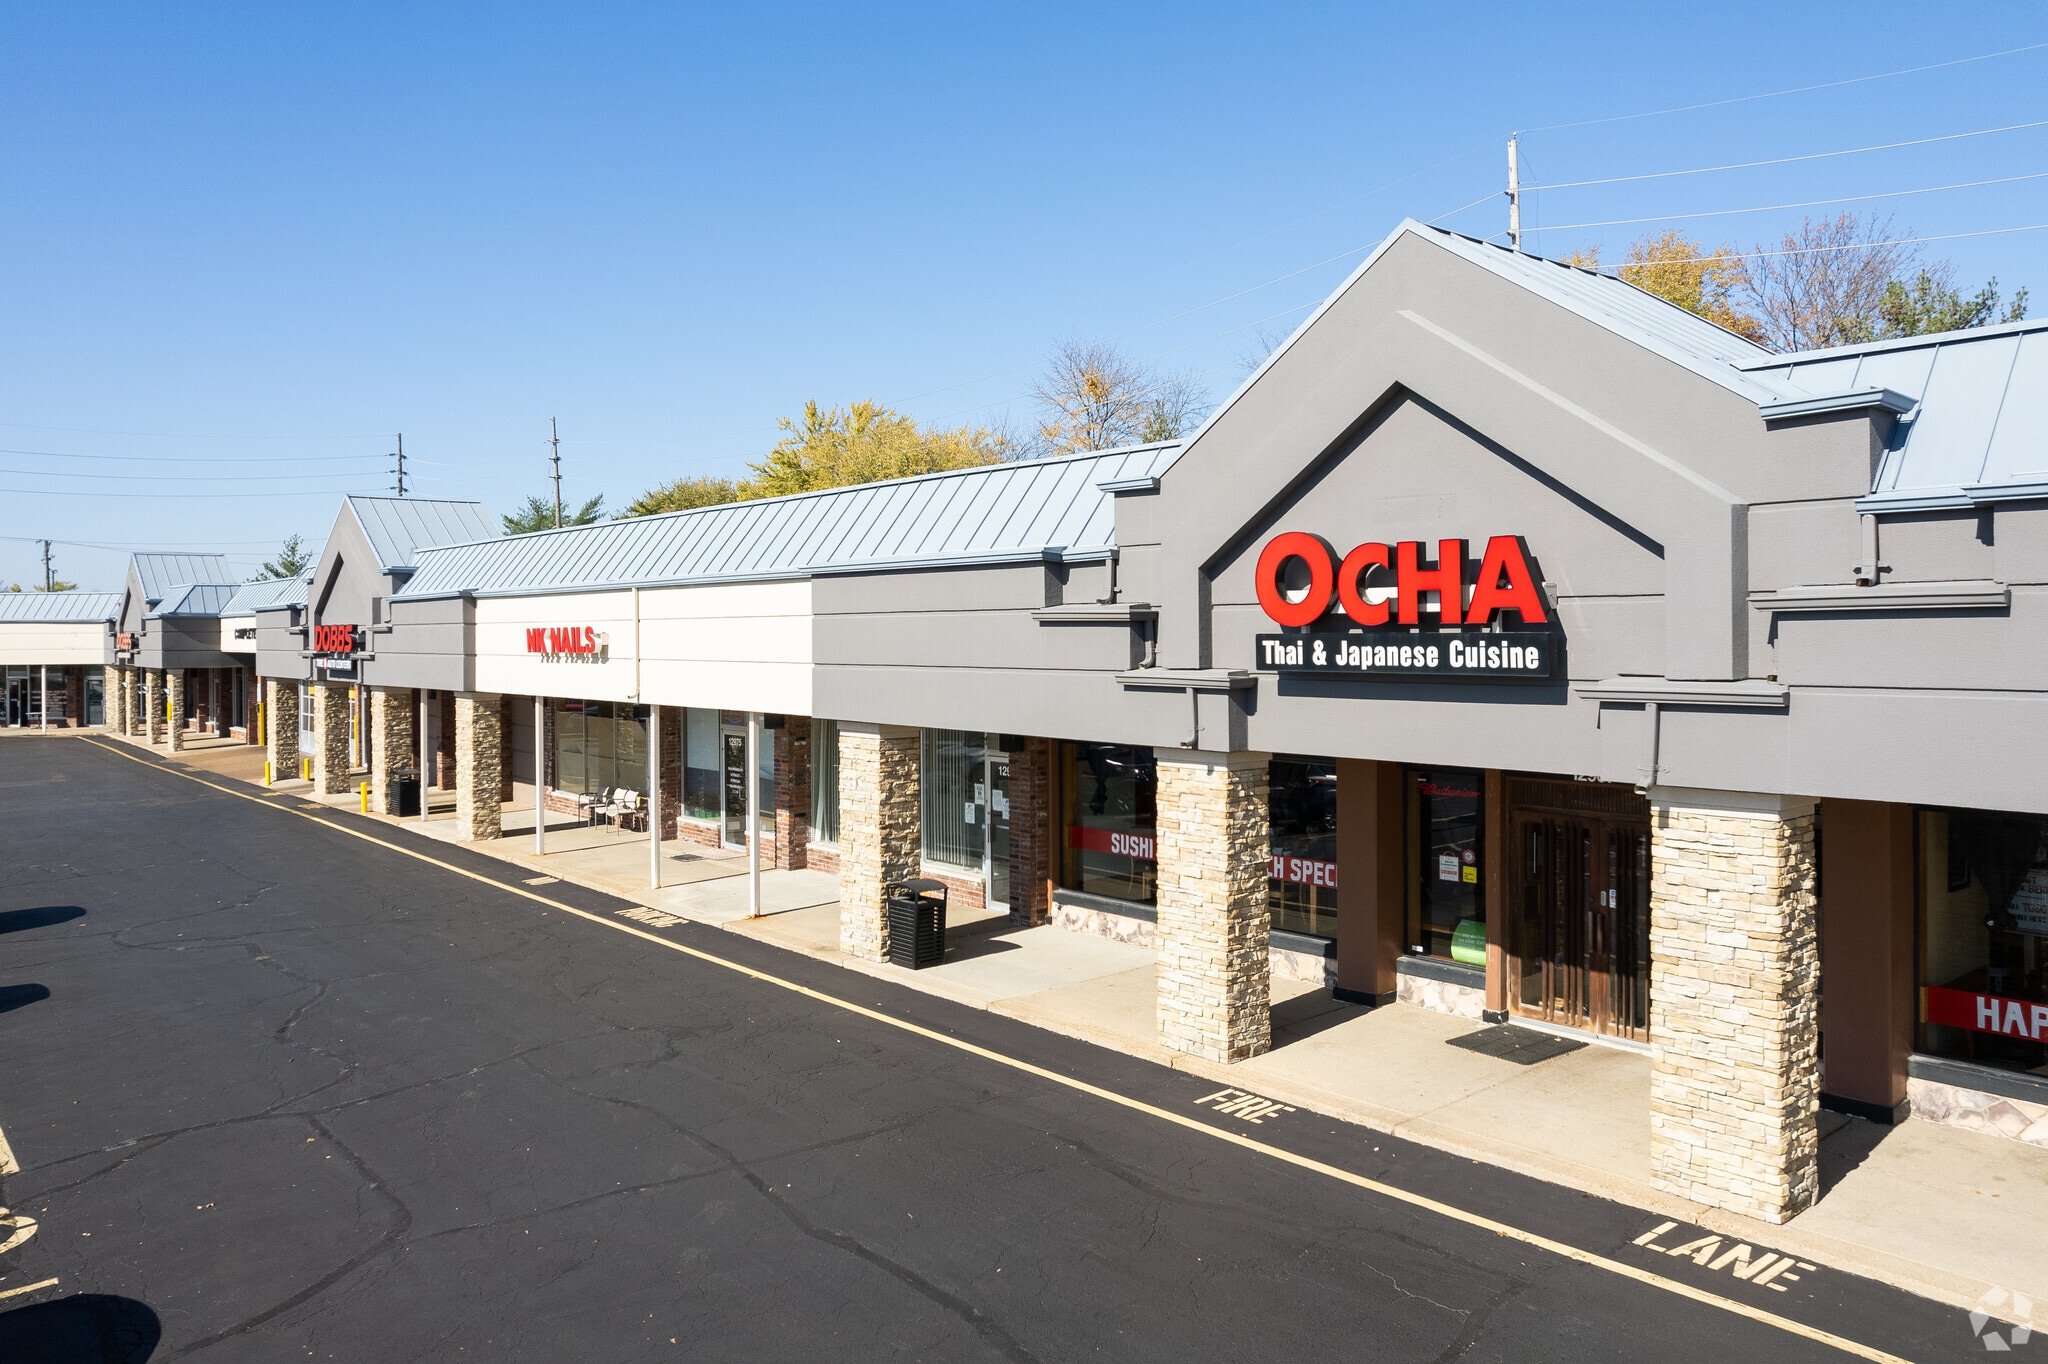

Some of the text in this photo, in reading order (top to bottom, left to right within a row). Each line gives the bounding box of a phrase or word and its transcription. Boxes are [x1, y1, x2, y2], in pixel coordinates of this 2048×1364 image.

[1255, 531, 1548, 627] OCHA
[314, 624, 353, 652] DOBBS
[526, 626, 596, 653] NK NAILS
[1262, 640, 1539, 670] Thai & Japanese Cuisine
[1420, 782, 1481, 797] Budweiser
[1111, 833, 1153, 858] SUSHI
[1290, 858, 1338, 887] SPEC
[1976, 996, 2048, 1039] HAP
[1193, 1088, 1296, 1124] FIRE
[1632, 1221, 1817, 1292] LANE
